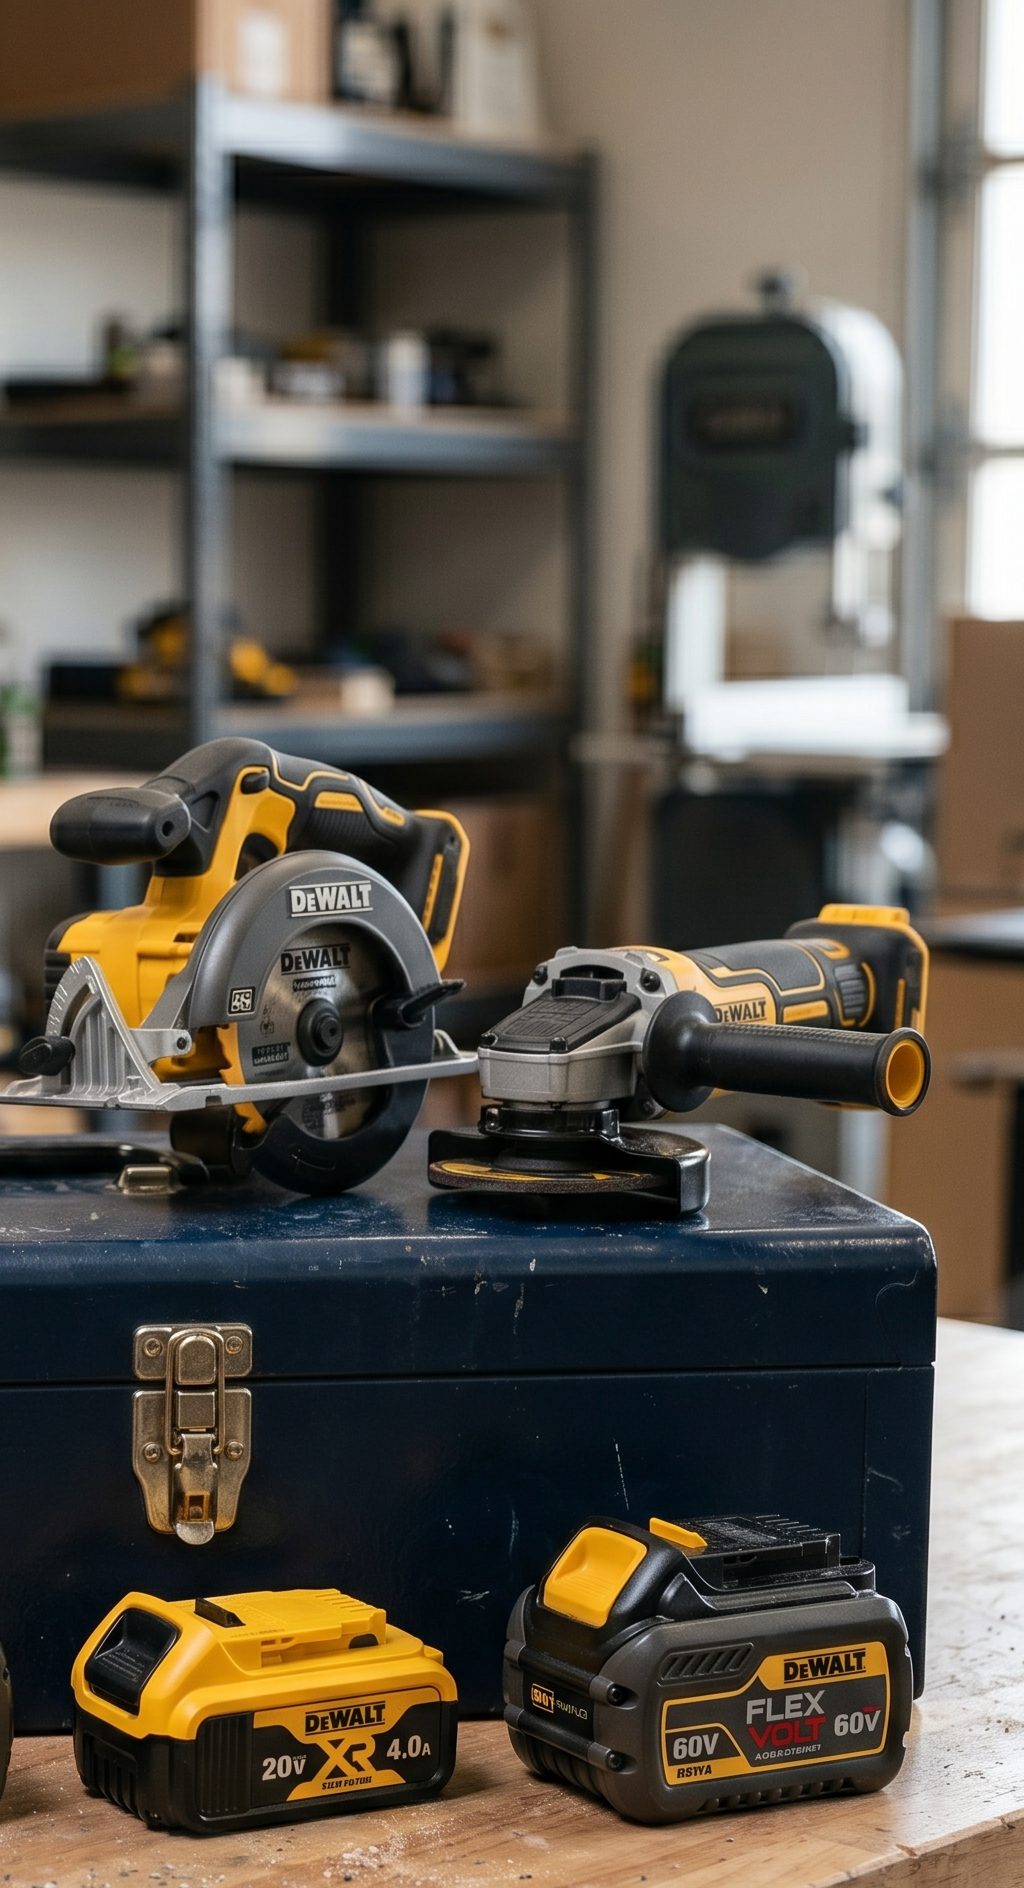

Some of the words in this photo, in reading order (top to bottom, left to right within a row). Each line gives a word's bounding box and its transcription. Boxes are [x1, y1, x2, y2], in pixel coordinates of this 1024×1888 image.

[747, 1690, 825, 1725] FLEX
[747, 1717, 826, 1749] VOLT
[834, 1710, 881, 1737] 60V
[673, 1733, 719, 1760] 60V
[262, 1756, 307, 1781] 20V
